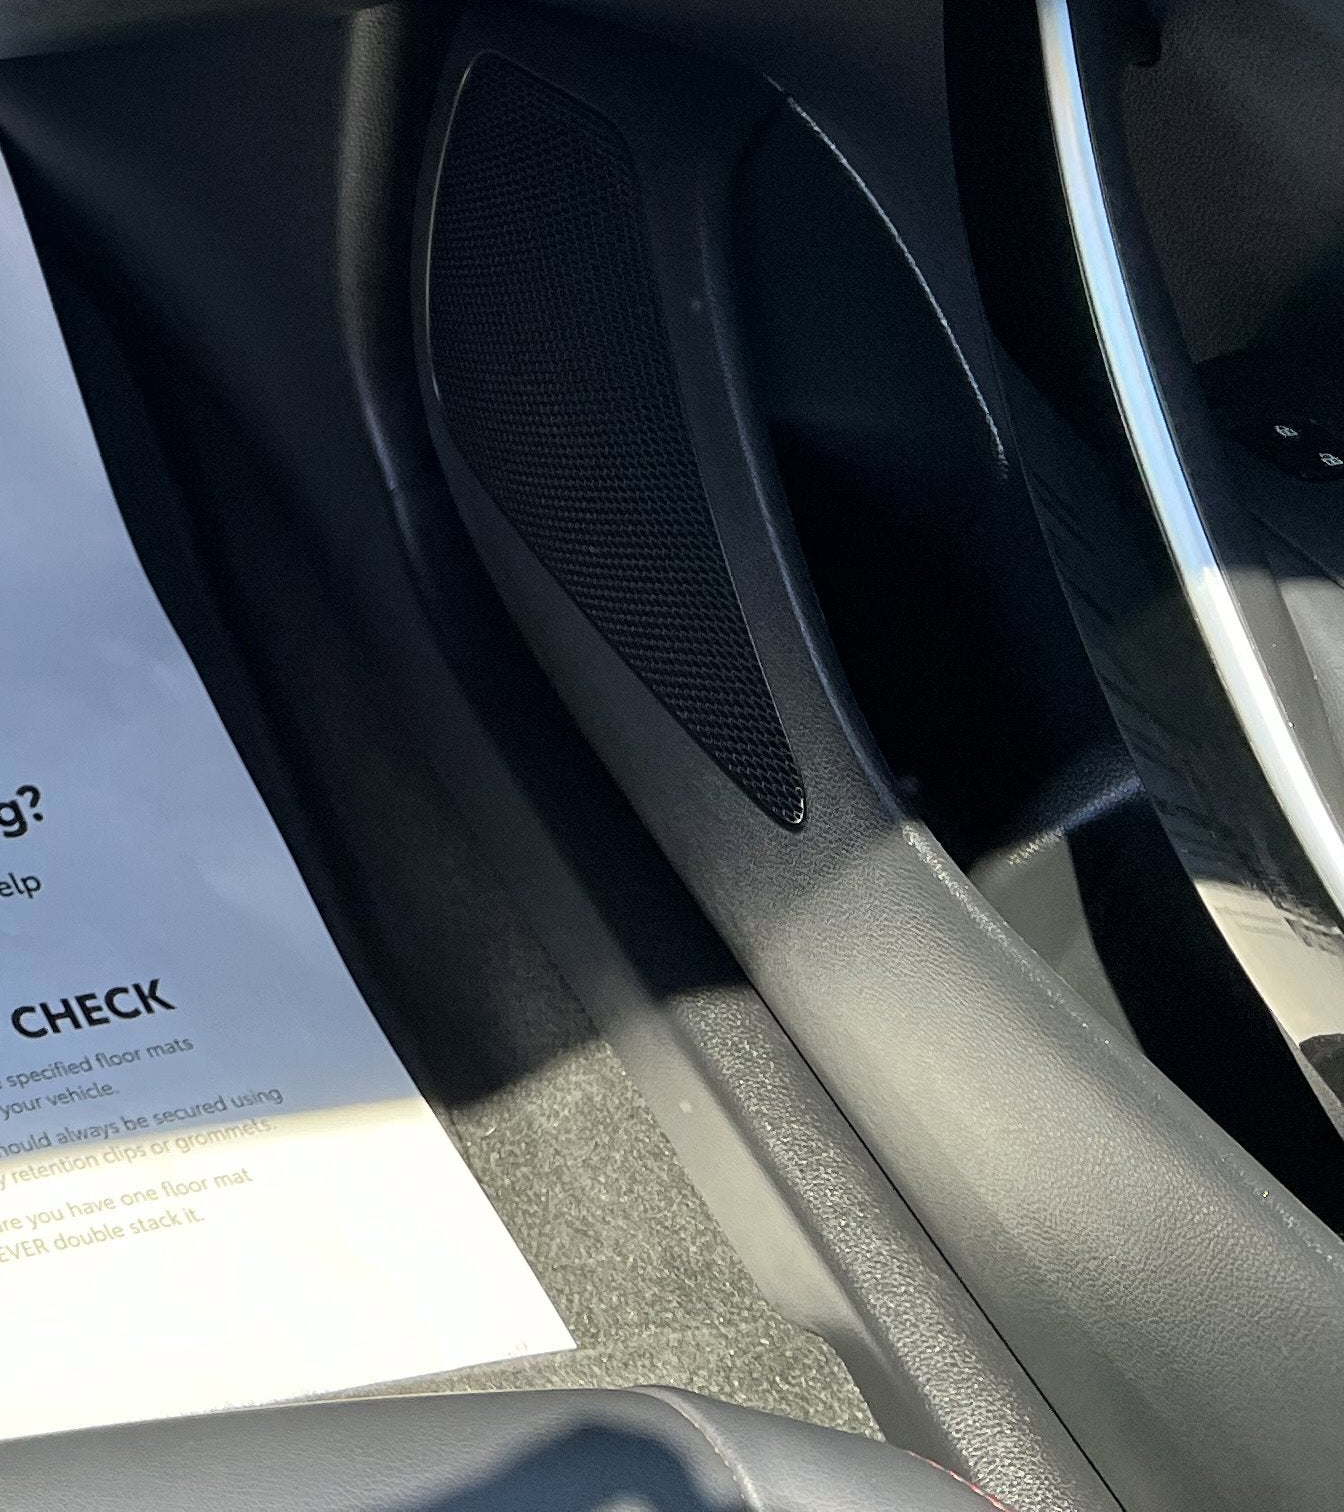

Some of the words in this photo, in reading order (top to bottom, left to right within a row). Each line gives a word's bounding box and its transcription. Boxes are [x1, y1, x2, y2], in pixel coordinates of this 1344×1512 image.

[11, 979, 176, 1038] CHECK
[6, 1056, 93, 1089] specified
[95, 1049, 141, 1068] floor
[146, 1038, 194, 1058] mats
[45, 1082, 120, 1106] vehicle.
[56, 1122, 120, 1145] always
[123, 1114, 149, 1131] be
[152, 1096, 228, 1126] secured
[231, 1088, 284, 1109] using
[12, 1155, 99, 1183] retention
[103, 1146, 146, 1163] clips
[151, 1141, 169, 1154] or
[175, 1119, 277, 1153] grommets.
[25, 1209, 65, 1230] you
[65, 1198, 117, 1217] have
[120, 1188, 159, 1206] one
[160, 1178, 208, 1197] floor
[213, 1168, 254, 1188] mat
[53, 1224, 125, 1251] double
[129, 1210, 183, 1235] stack
[182, 1208, 206, 1224] it.
